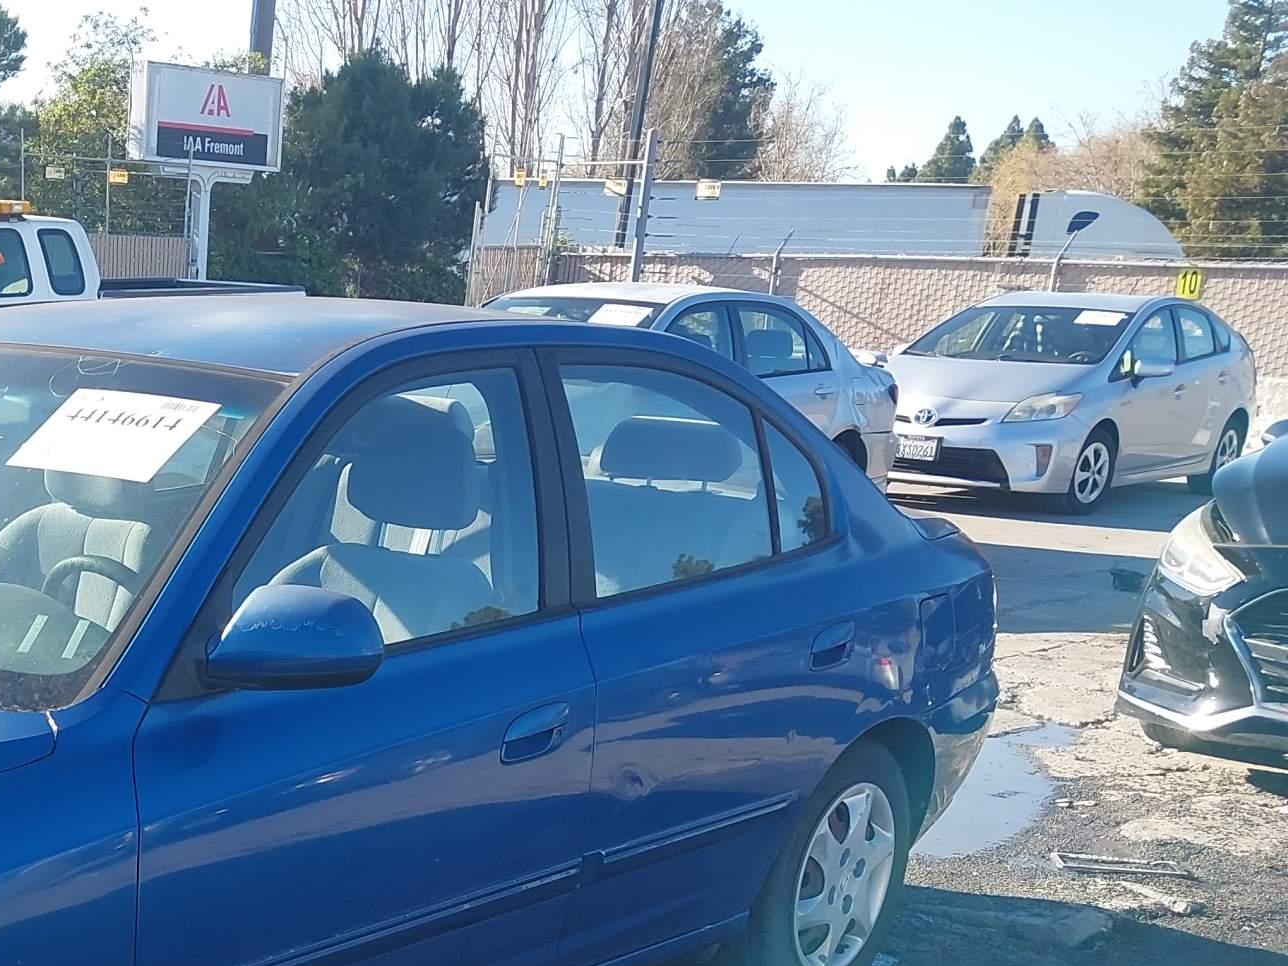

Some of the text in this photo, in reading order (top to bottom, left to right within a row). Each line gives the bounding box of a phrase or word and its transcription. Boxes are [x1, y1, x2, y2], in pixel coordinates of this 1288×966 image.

[183, 135, 244, 156] IAA Fremont
[1181, 270, 1199, 295] 10
[67, 408, 183, 431] 44146614
